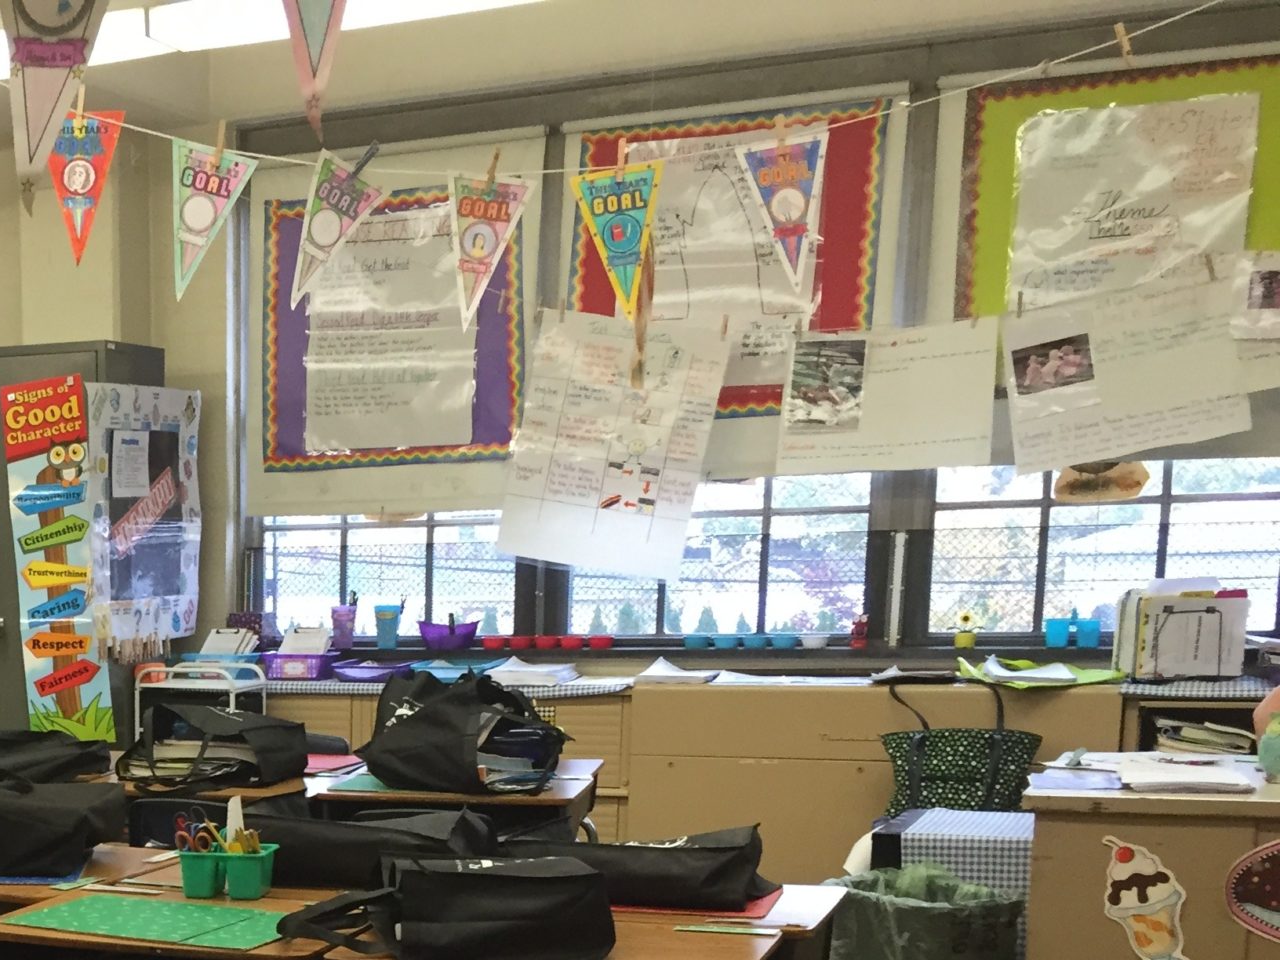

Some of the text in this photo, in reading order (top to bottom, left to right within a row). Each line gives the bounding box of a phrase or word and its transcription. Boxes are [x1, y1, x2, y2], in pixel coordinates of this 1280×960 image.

[60, 126, 74, 135] HIS
[180, 165, 231, 198] GOAL
[759, 160, 811, 187] GOAL
[318, 181, 360, 220] GOAL
[460, 196, 511, 221] GOAL
[592, 191, 647, 215] GOAL
[14, 384, 69, 404] Signs of
[5, 395, 81, 430] Good
[6, 420, 82, 445] Character
[17, 490, 82, 504] Responsibility
[24, 521, 85, 547] Citizenship
[27, 567, 88, 578] Trustworthines
[31, 597, 81, 619] Caring
[31, 638, 85, 651] Respect
[39, 666, 90, 692] Fairness
